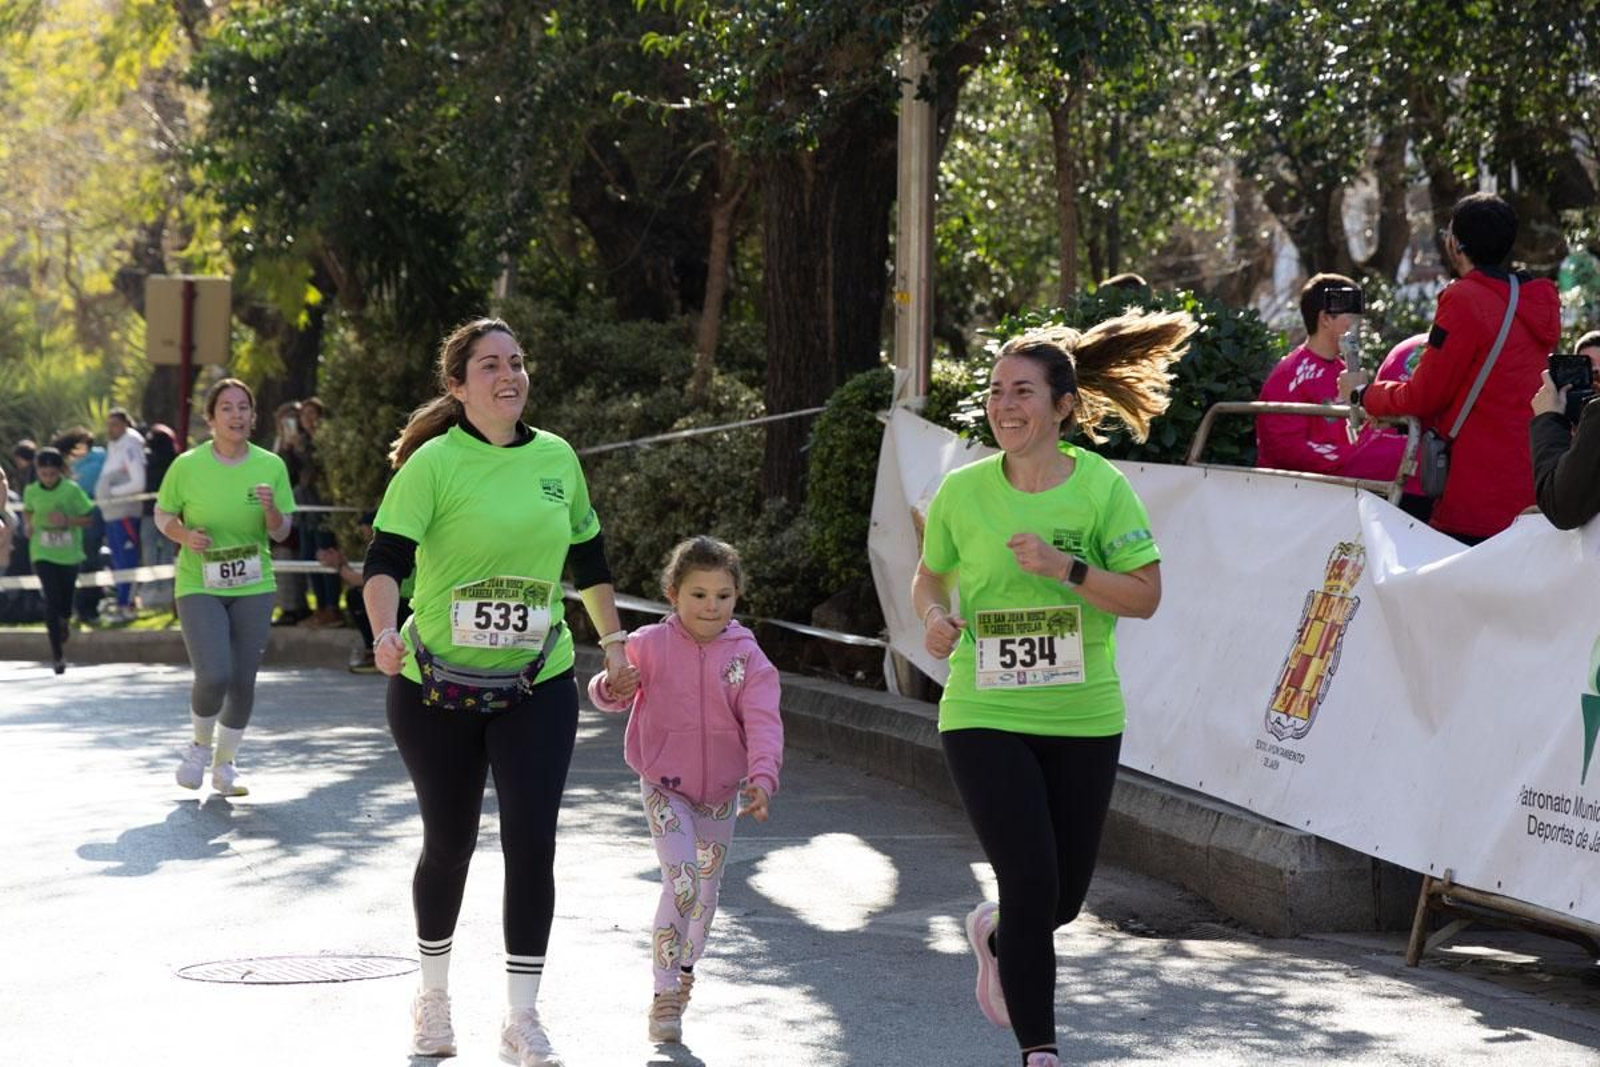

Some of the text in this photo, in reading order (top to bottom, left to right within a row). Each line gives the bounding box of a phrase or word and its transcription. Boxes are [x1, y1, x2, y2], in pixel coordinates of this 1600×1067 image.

[220, 560, 246, 578] 612
[474, 602, 528, 632] 533
[999, 636, 1056, 669] 534
[1528, 814, 1574, 845] Deportes
[1576, 827, 1588, 849] de
